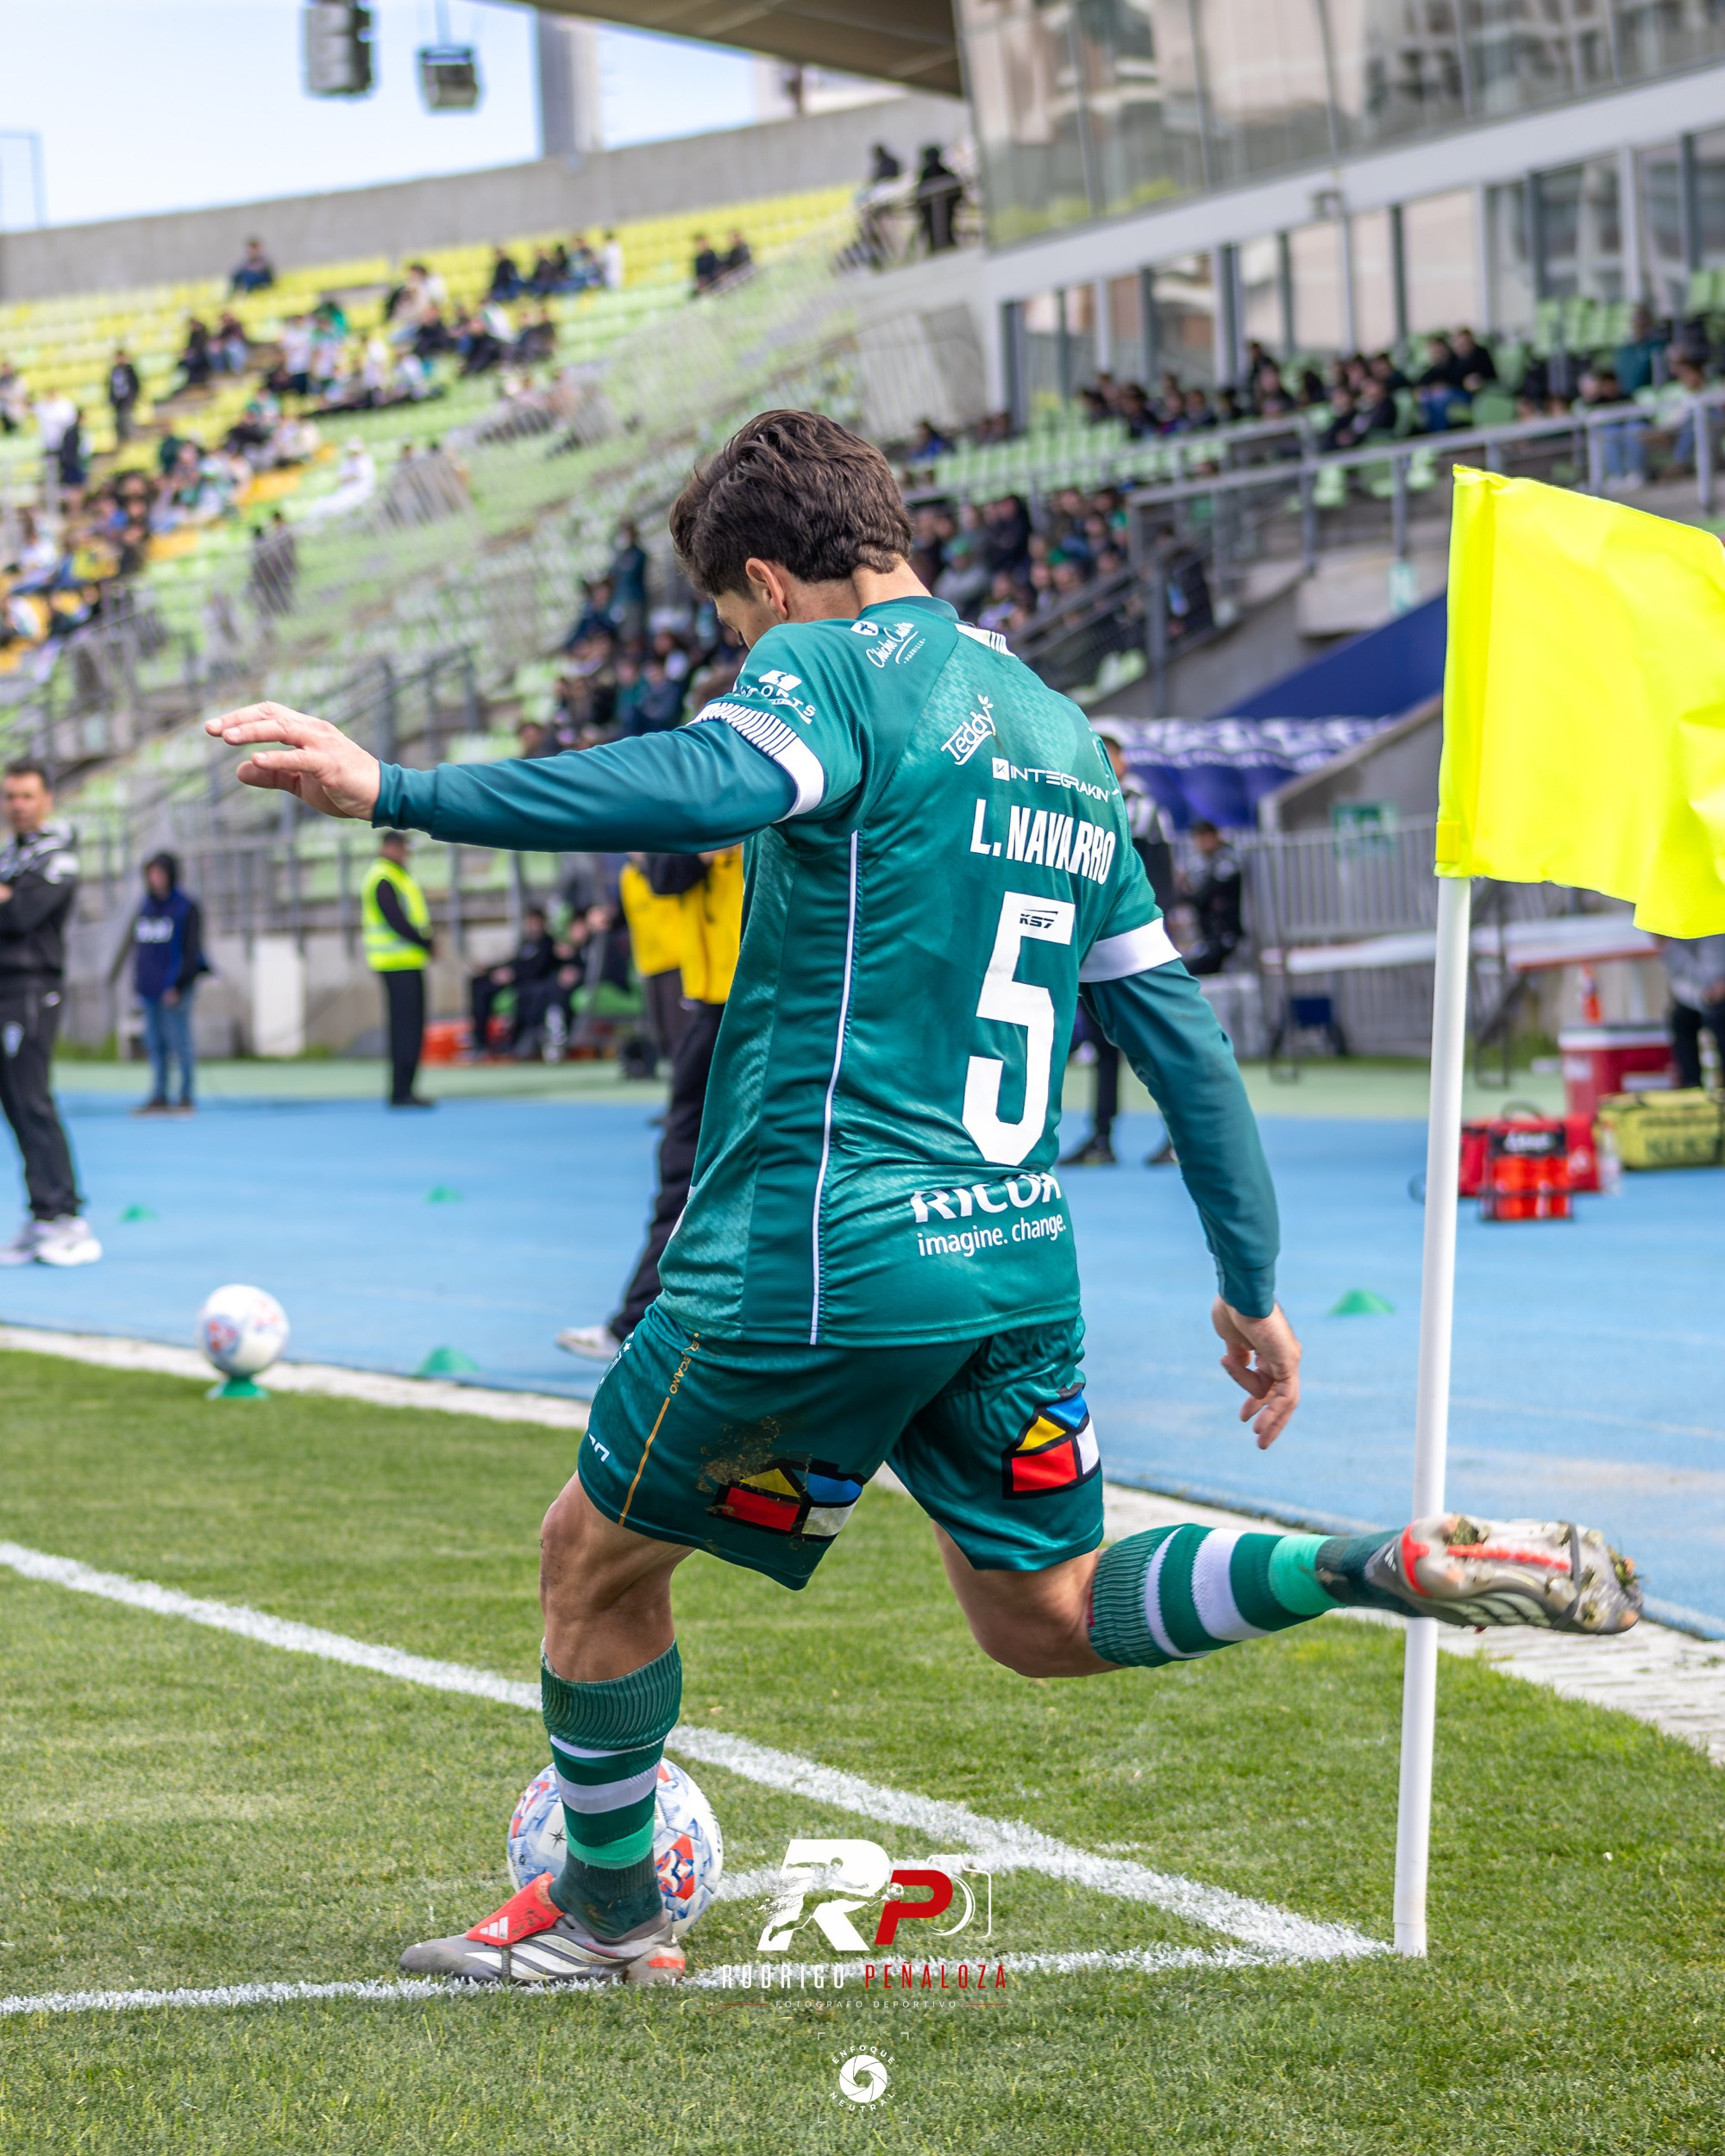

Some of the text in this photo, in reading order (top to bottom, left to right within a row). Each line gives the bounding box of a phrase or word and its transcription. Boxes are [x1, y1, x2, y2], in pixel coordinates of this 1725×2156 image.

[941, 705, 996, 766] Teddy
[1011, 765, 1108, 803] INTEGRAKIN
[1007, 805, 1115, 885] NAVARRO
[962, 891, 1076, 1166] 5
[917, 1213, 1066, 1257] imagine. change.
[670, 1351, 692, 1395] ECANO
